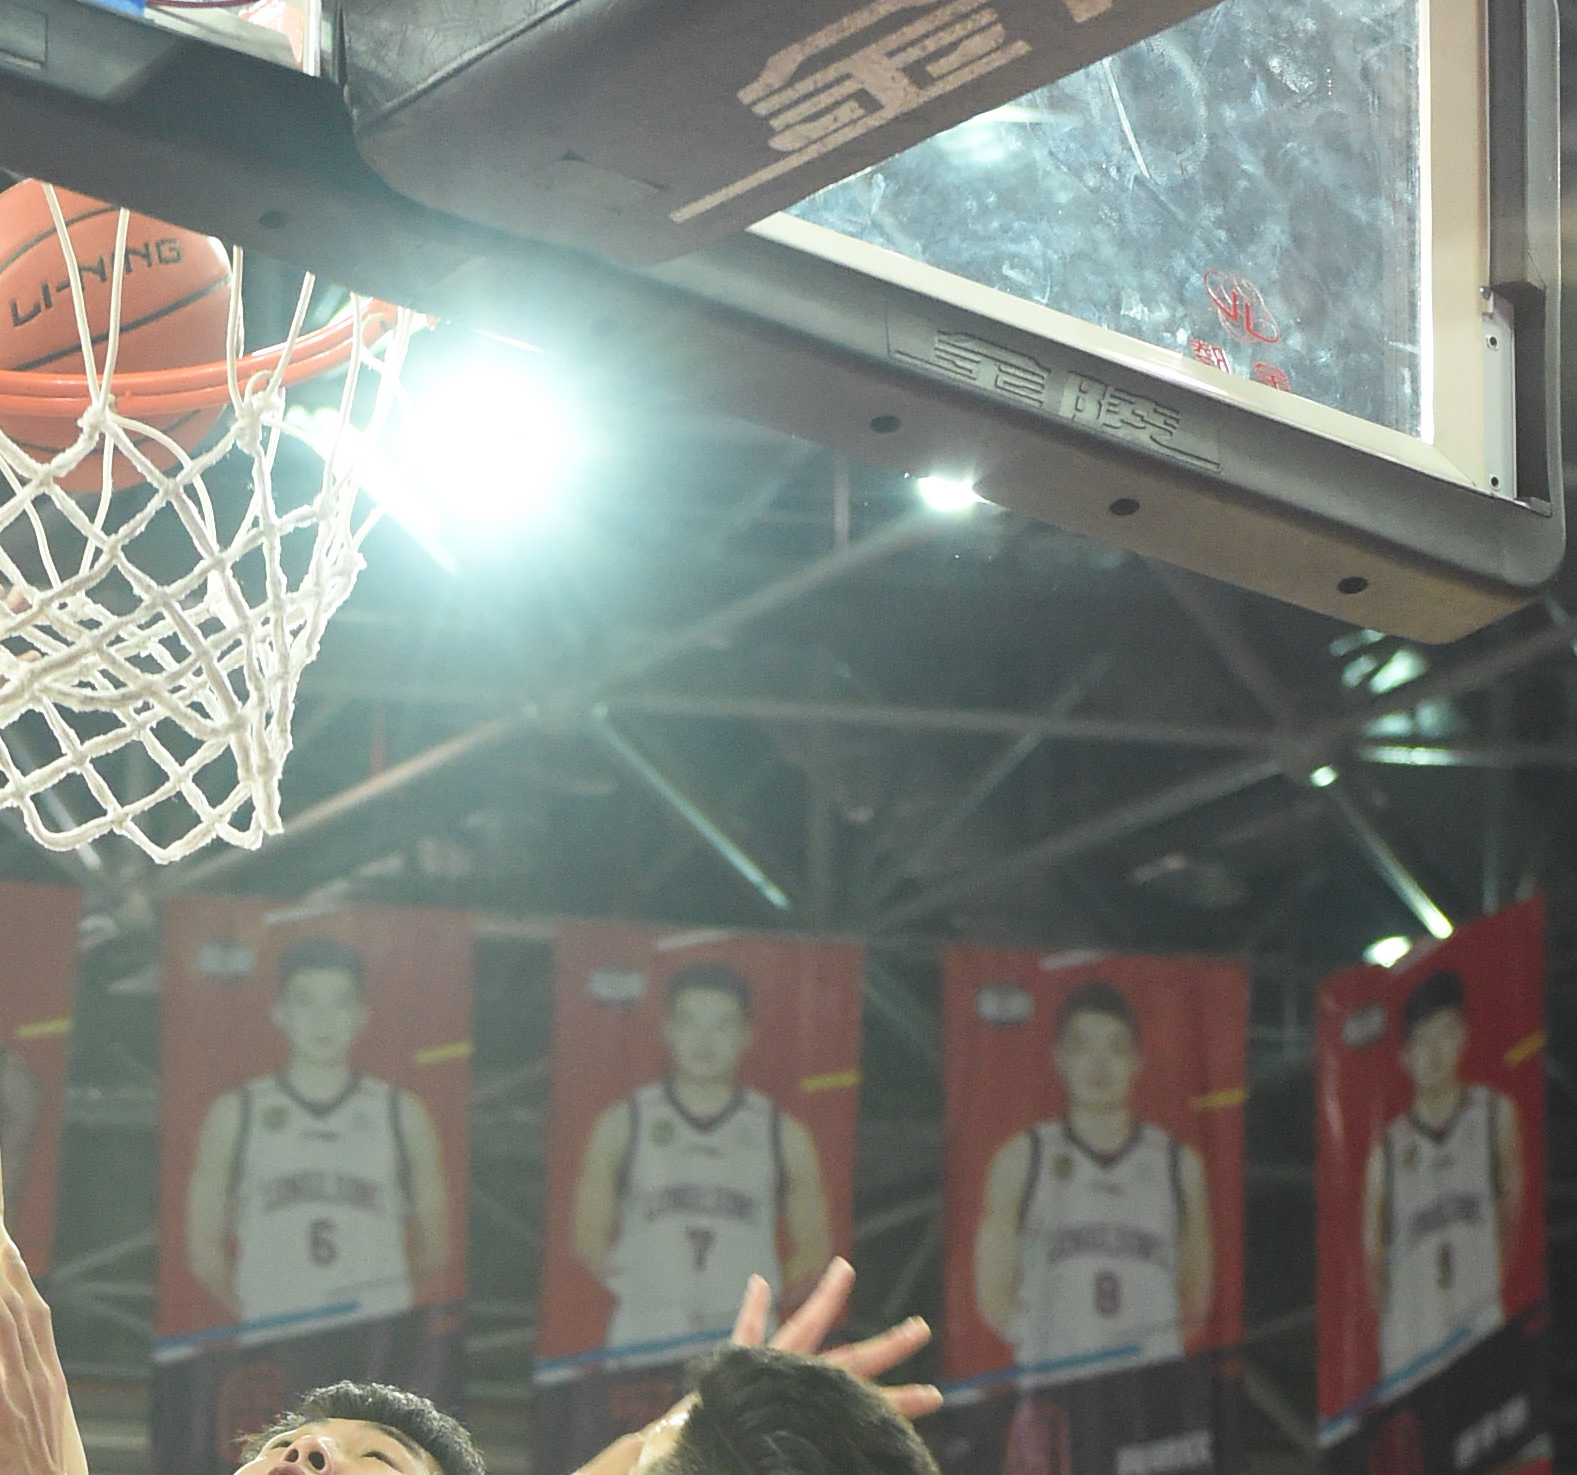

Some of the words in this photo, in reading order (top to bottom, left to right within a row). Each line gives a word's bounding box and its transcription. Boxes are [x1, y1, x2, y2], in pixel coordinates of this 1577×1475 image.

[9, 237, 182, 328] LI-NING
[307, 1215, 341, 1269] 6
[684, 1223, 718, 1273] 7
